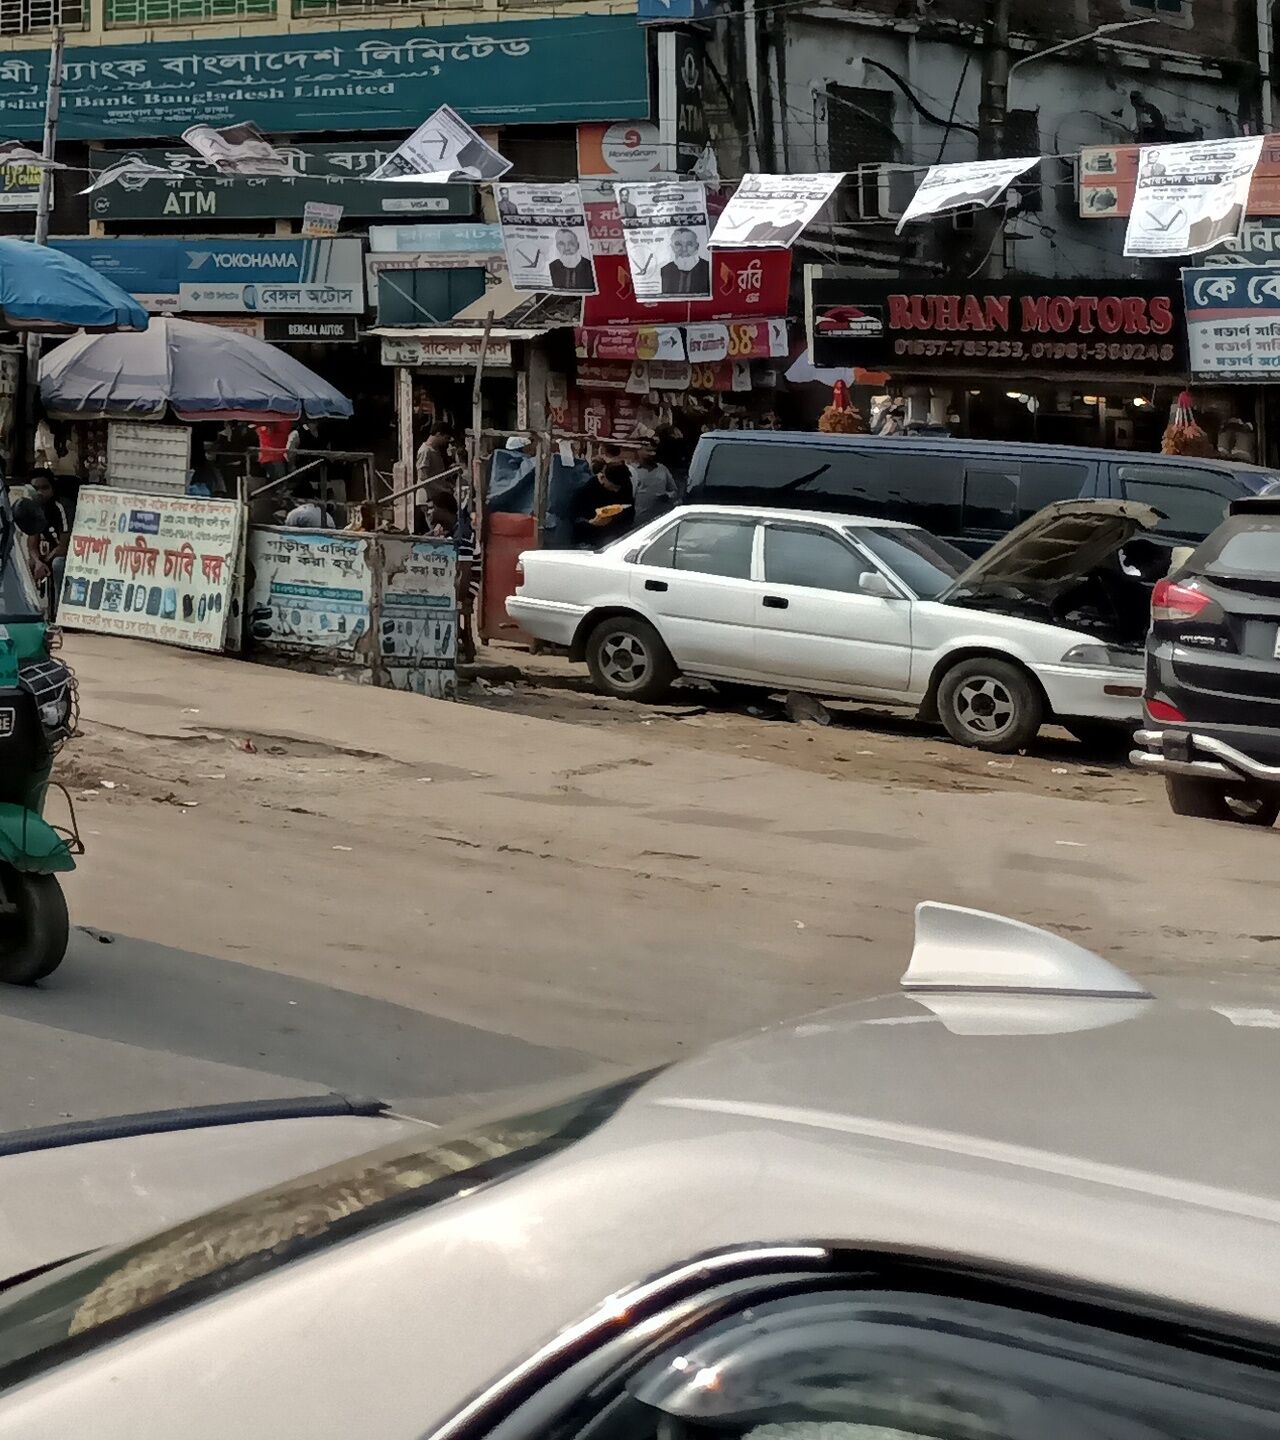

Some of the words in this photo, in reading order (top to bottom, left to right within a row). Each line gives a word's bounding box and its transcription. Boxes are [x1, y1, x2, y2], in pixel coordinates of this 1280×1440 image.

[160, 45, 344, 77] বাংলাদেশ
[355, 34, 532, 67] লিমিটেড
[74, 93, 136, 107] Bank
[144, 86, 284, 104] Bangladesh
[295, 81, 395, 99] Limited
[608, 148, 657, 159] MoneyGram
[163, 190, 217, 214] ATM
[212, 252, 299, 269] YOKOHAMA
[737, 259, 763, 291] রবি
[261, 285, 301, 305] বেঙ্গল
[307, 285, 354, 305] অটোস
[1193, 276, 1237, 306] কে
[887, 294, 1012, 332] RUHAN
[1019, 295, 1174, 334] MOTORS
[288, 324, 318, 336] BENGAL
[319, 324, 345, 336] AUTOS
[73, 534, 111, 566] আশা
[114, 534, 160, 580] গাড়ীর
[163, 542, 197, 584] চাবি
